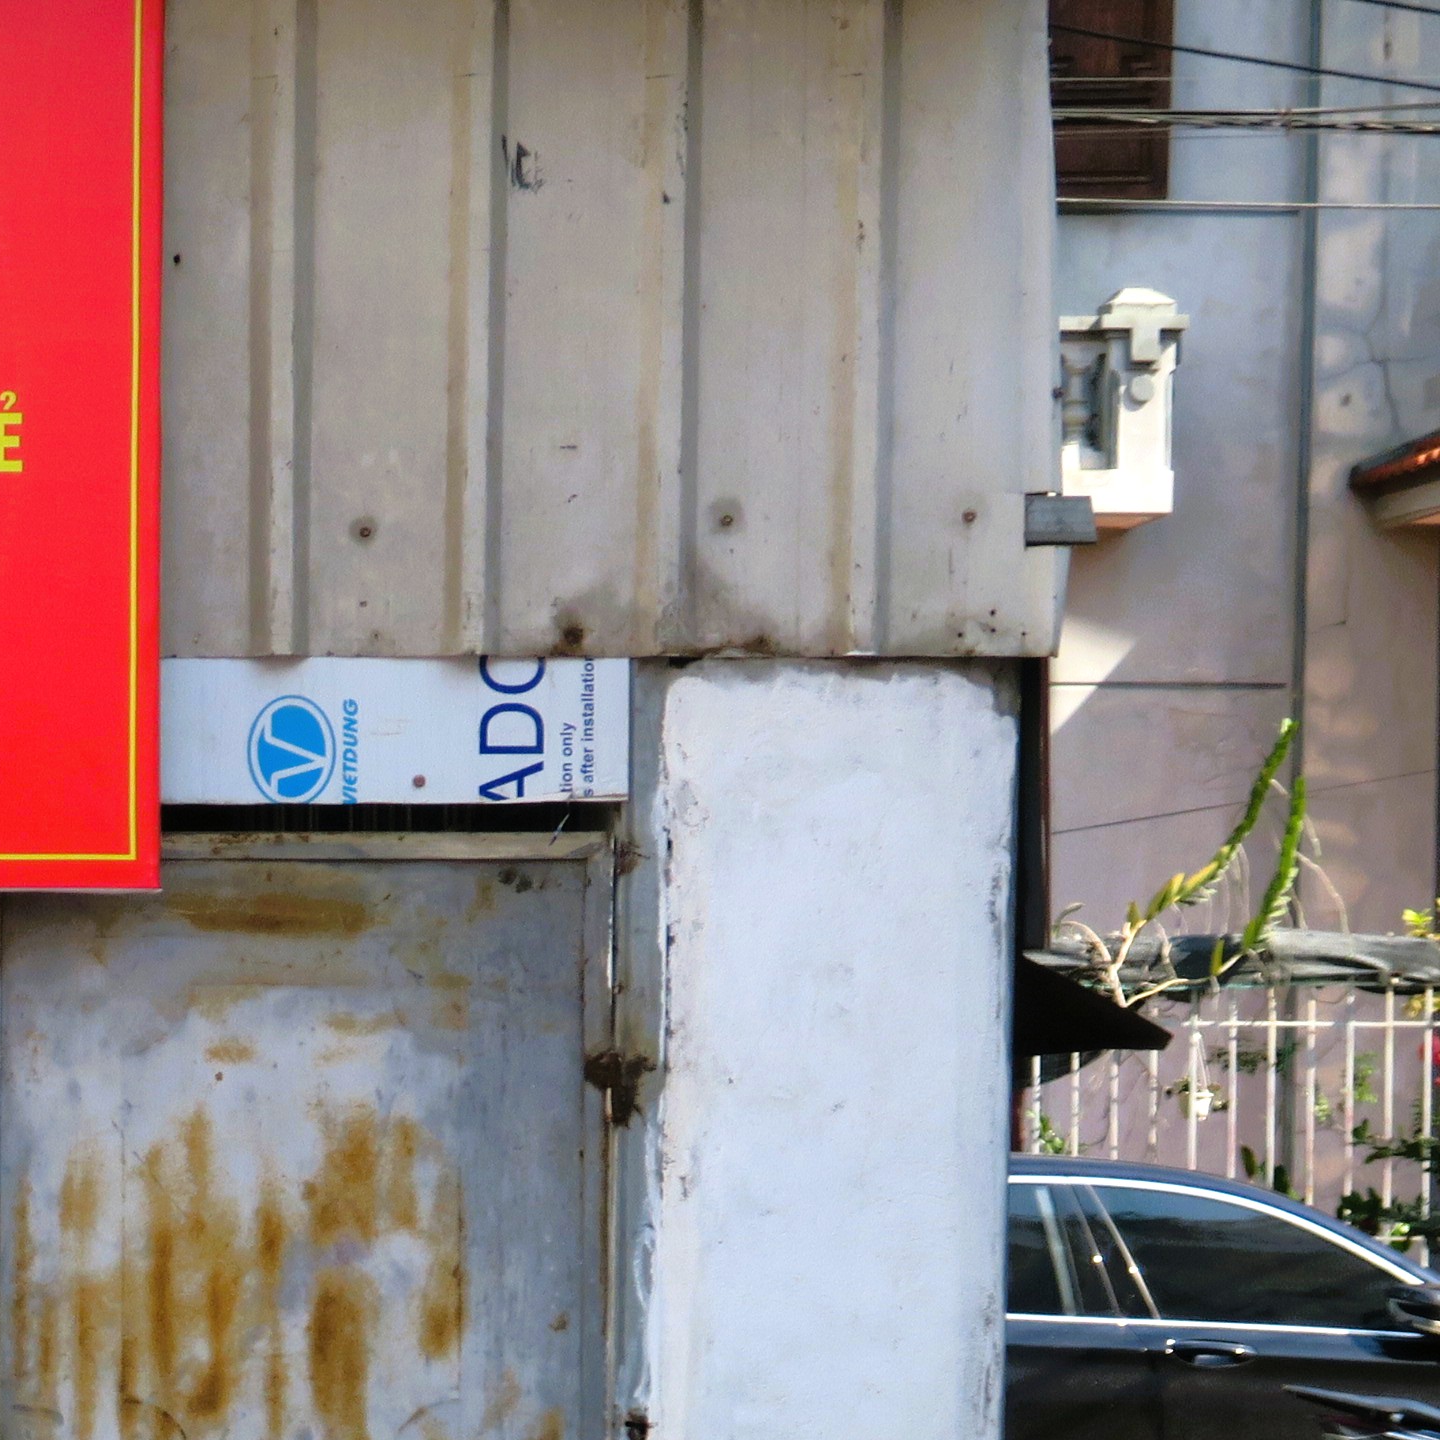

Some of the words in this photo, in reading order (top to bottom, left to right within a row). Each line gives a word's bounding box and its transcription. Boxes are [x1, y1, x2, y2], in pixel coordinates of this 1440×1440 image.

[342, 699, 359, 805] VIETDUNG
[559, 722, 577, 757] only
[581, 746, 595, 783] after
